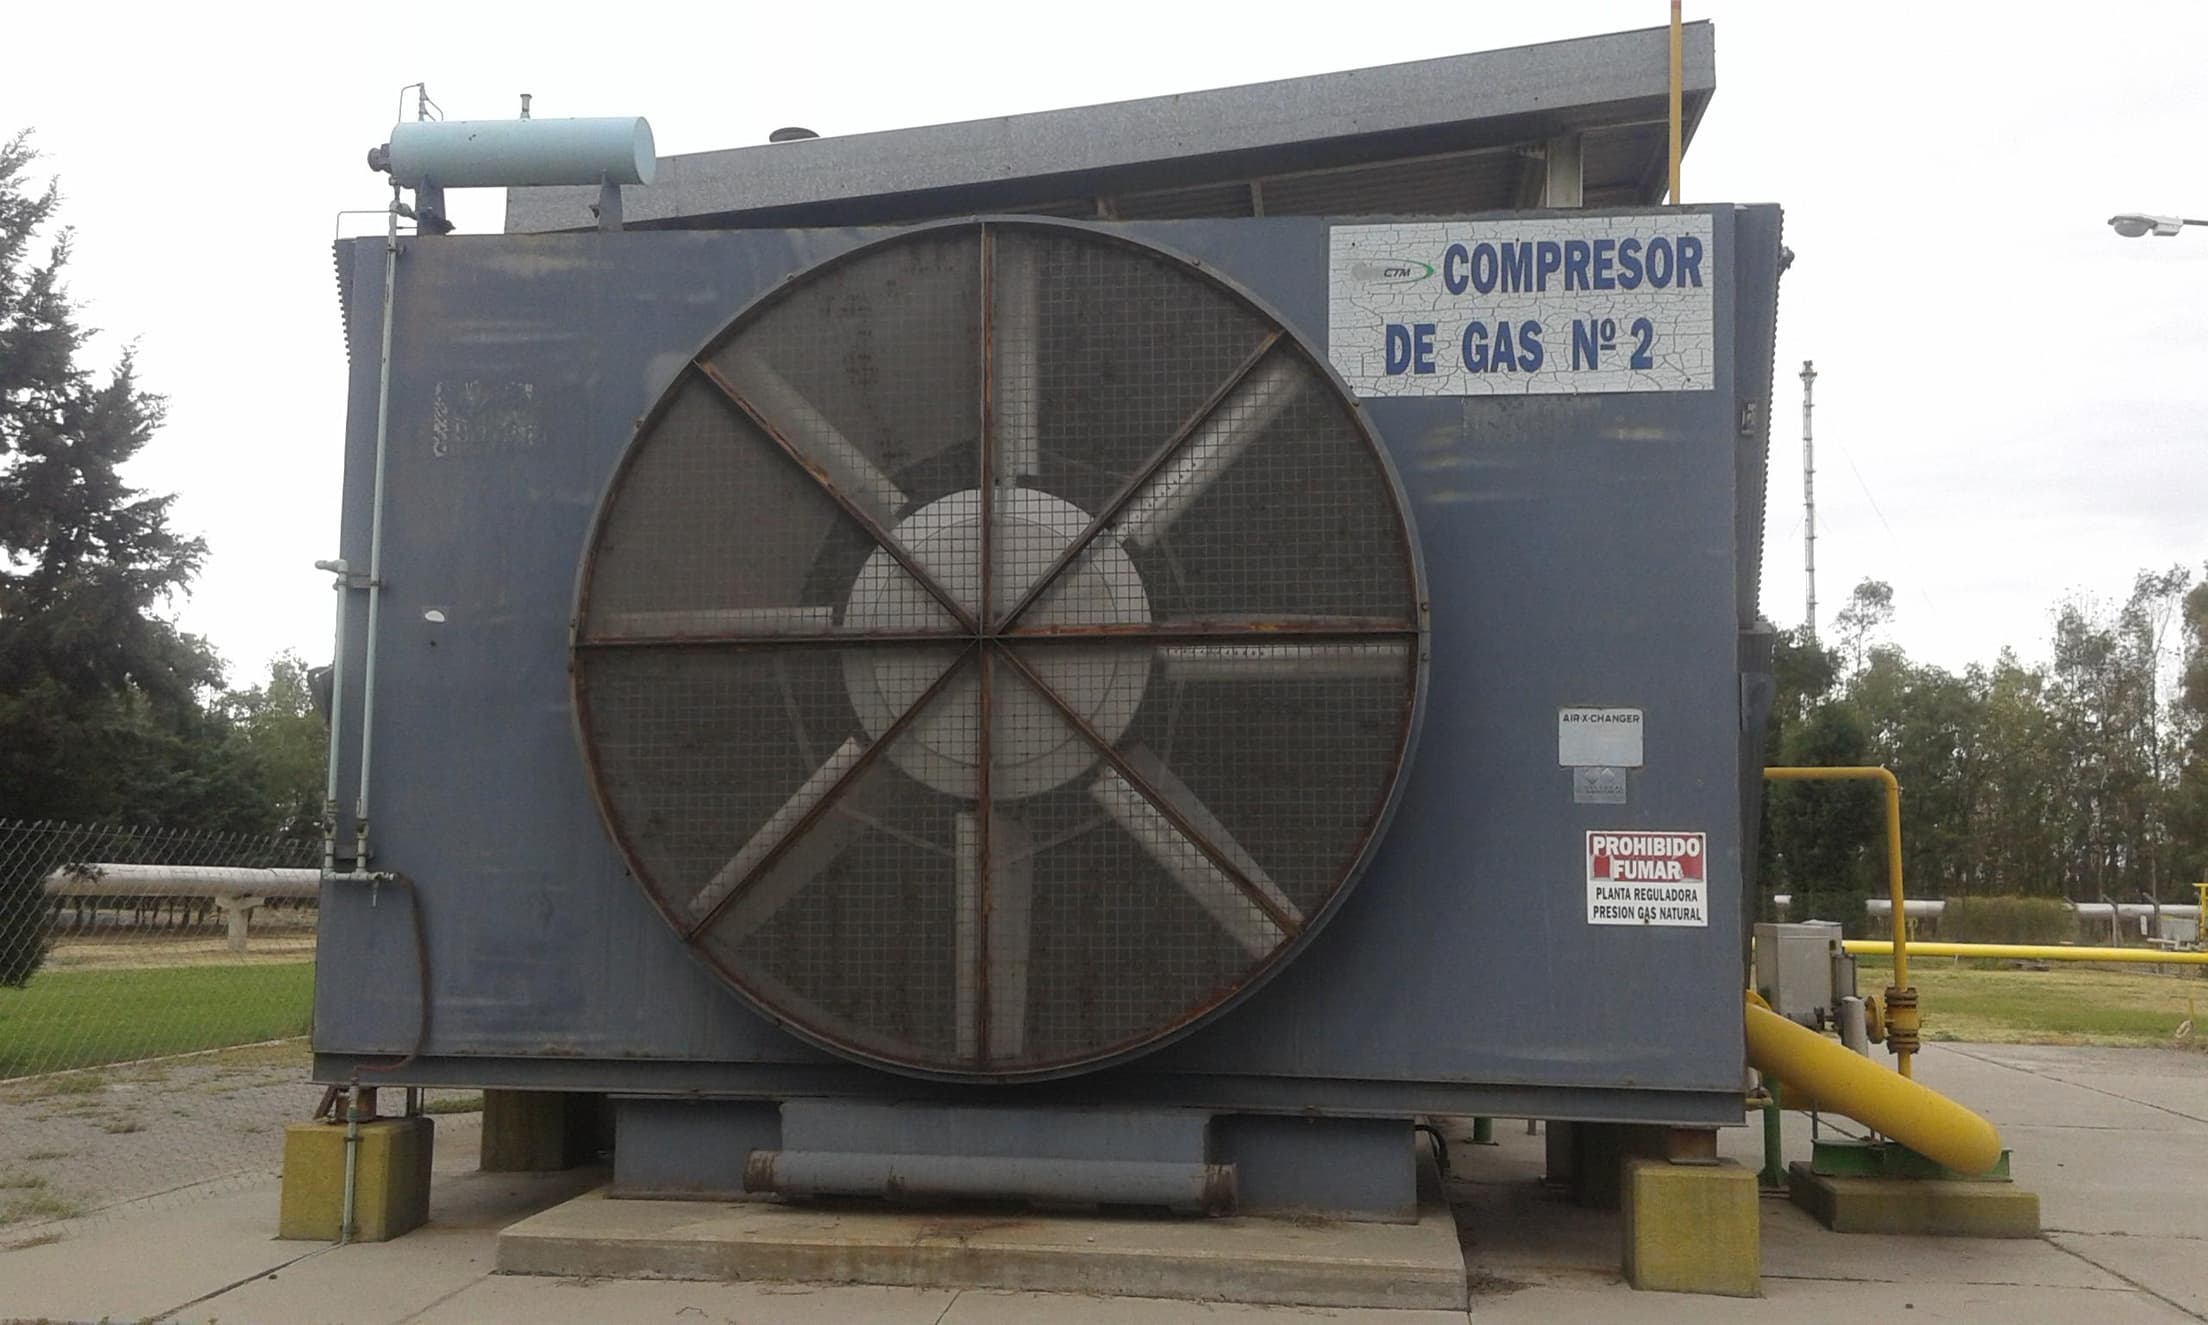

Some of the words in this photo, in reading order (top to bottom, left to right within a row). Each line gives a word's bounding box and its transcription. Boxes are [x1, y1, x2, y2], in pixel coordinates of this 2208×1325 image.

[1383, 267, 1411, 278] CTM
[1443, 236, 1704, 296] COMPRESOR
[1385, 323, 1436, 376] DE
[1461, 320, 1544, 373] GAS
[1630, 317, 1654, 370] 2
[1592, 836, 1701, 857] PROHIBIDO
[1612, 859, 1682, 880] FUMAR
[1596, 887, 1631, 901] PLANTA
[1634, 888, 1698, 902] REGULADORA
[1593, 905, 1635, 919] PRESION
[1637, 906, 1656, 920] GAS
[1659, 907, 1702, 921] NATURAL
